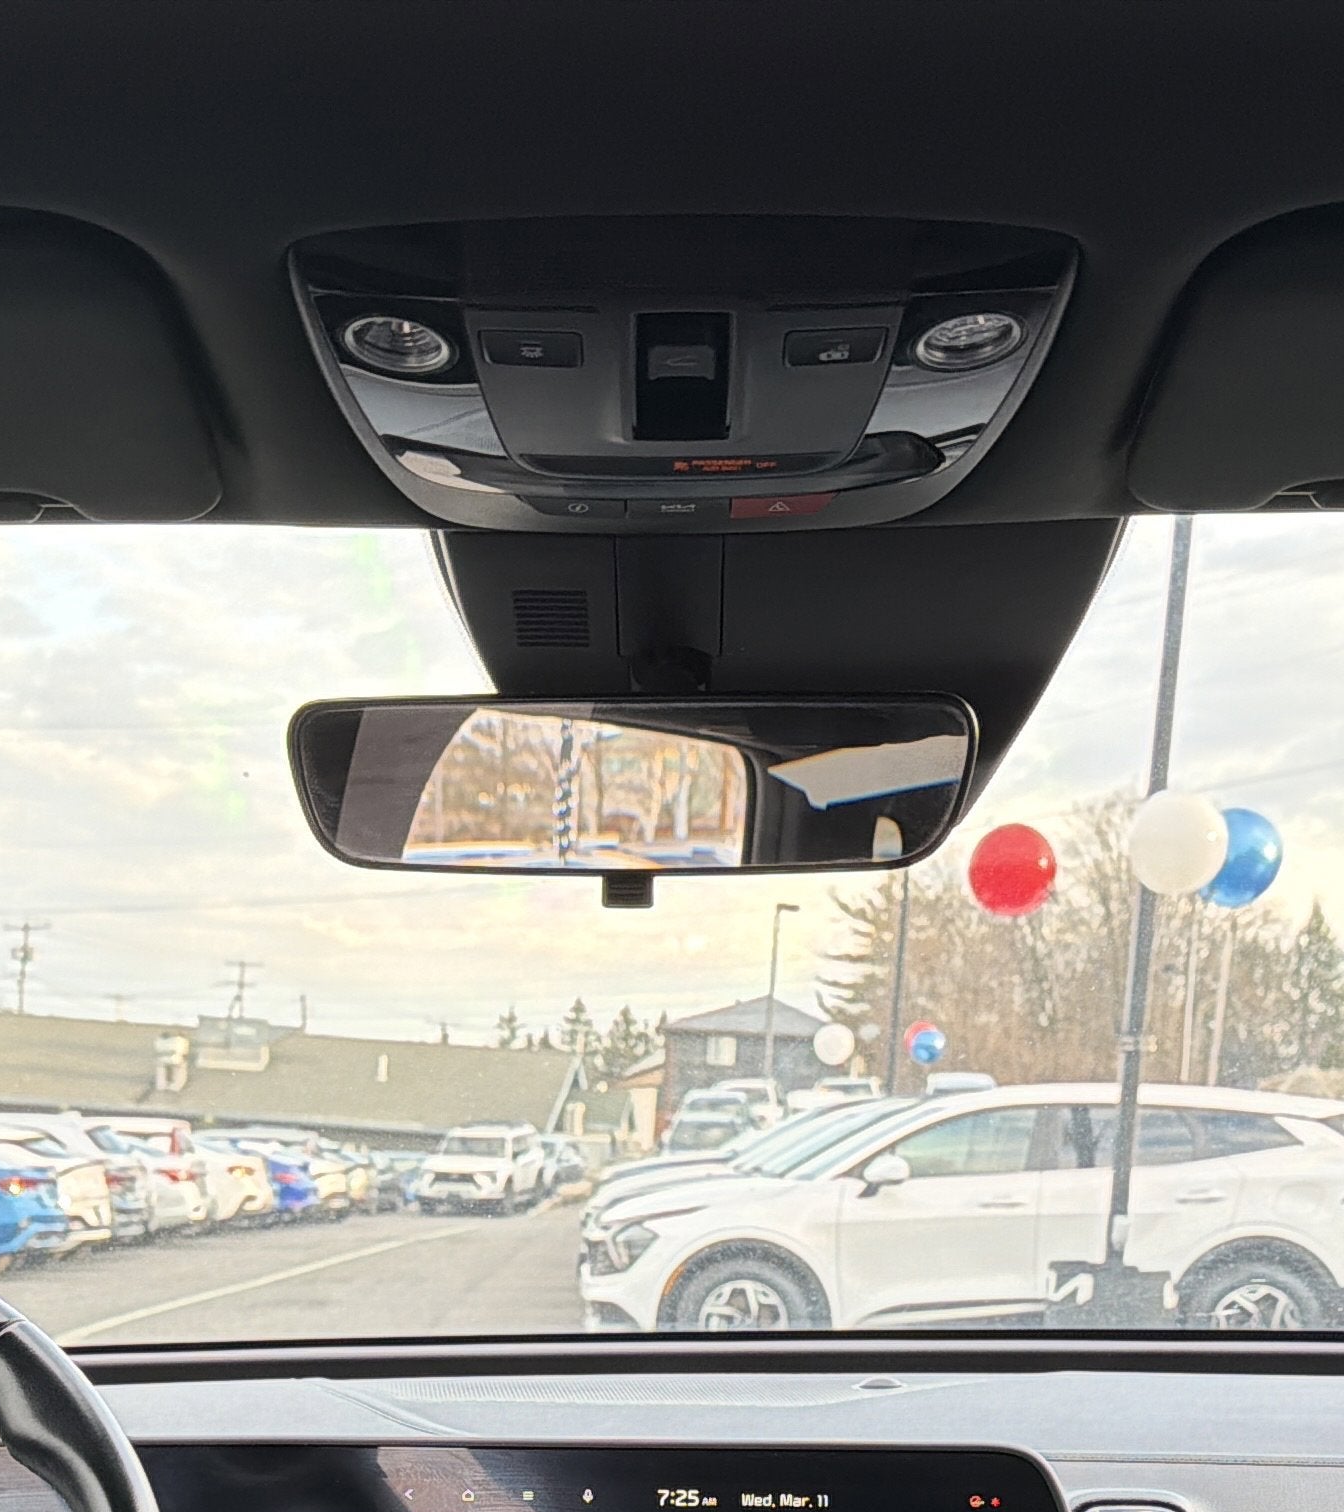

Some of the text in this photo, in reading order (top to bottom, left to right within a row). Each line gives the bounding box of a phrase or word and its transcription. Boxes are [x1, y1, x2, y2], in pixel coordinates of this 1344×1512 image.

[657, 1489, 718, 1507] 7:25 AM
[779, 1493, 813, 1508] Mar.
[817, 1494, 829, 1507] 11
